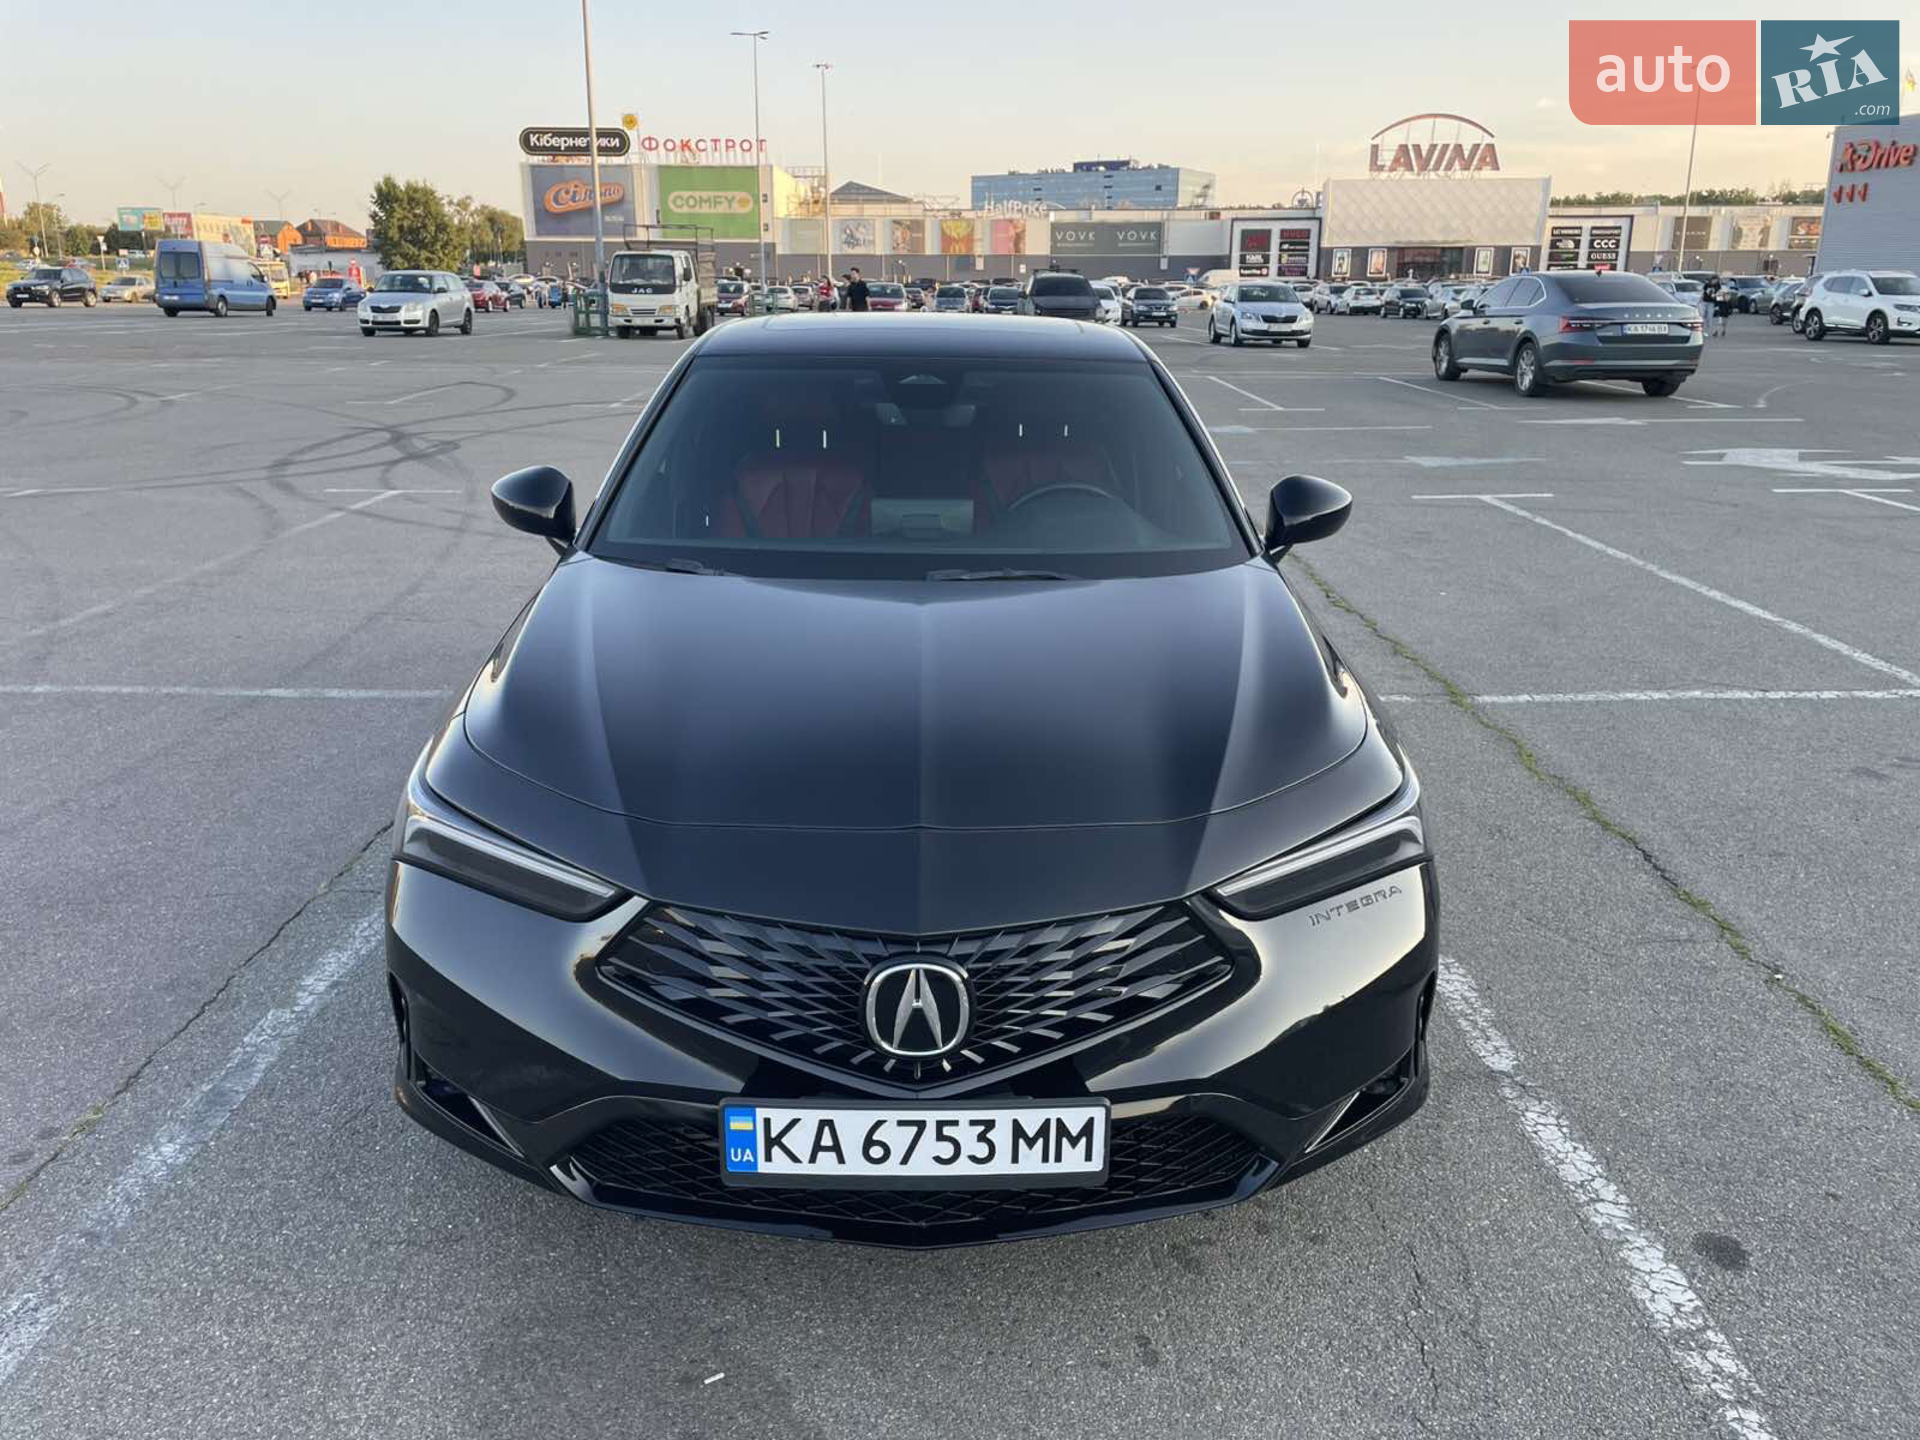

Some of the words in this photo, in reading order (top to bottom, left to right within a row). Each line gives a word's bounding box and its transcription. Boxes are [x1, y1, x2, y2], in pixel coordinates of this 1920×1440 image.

[641, 136, 767, 152] ФОКСТРОТ
[1369, 143, 1500, 172] LAVINA
[671, 194, 735, 209] COMFY
[1056, 231, 1095, 241] VOVK
[1116, 231, 1157, 241] VOVK
[1593, 239, 1617, 249] CCC
[1590, 252, 1617, 260] GUESS
[1308, 885, 1403, 927] INTEGRA
[762, 1117, 846, 1164] KA
[861, 1118, 997, 1166] 6753
[1010, 1116, 1095, 1164] MM
[730, 1148, 755, 1163] UA
